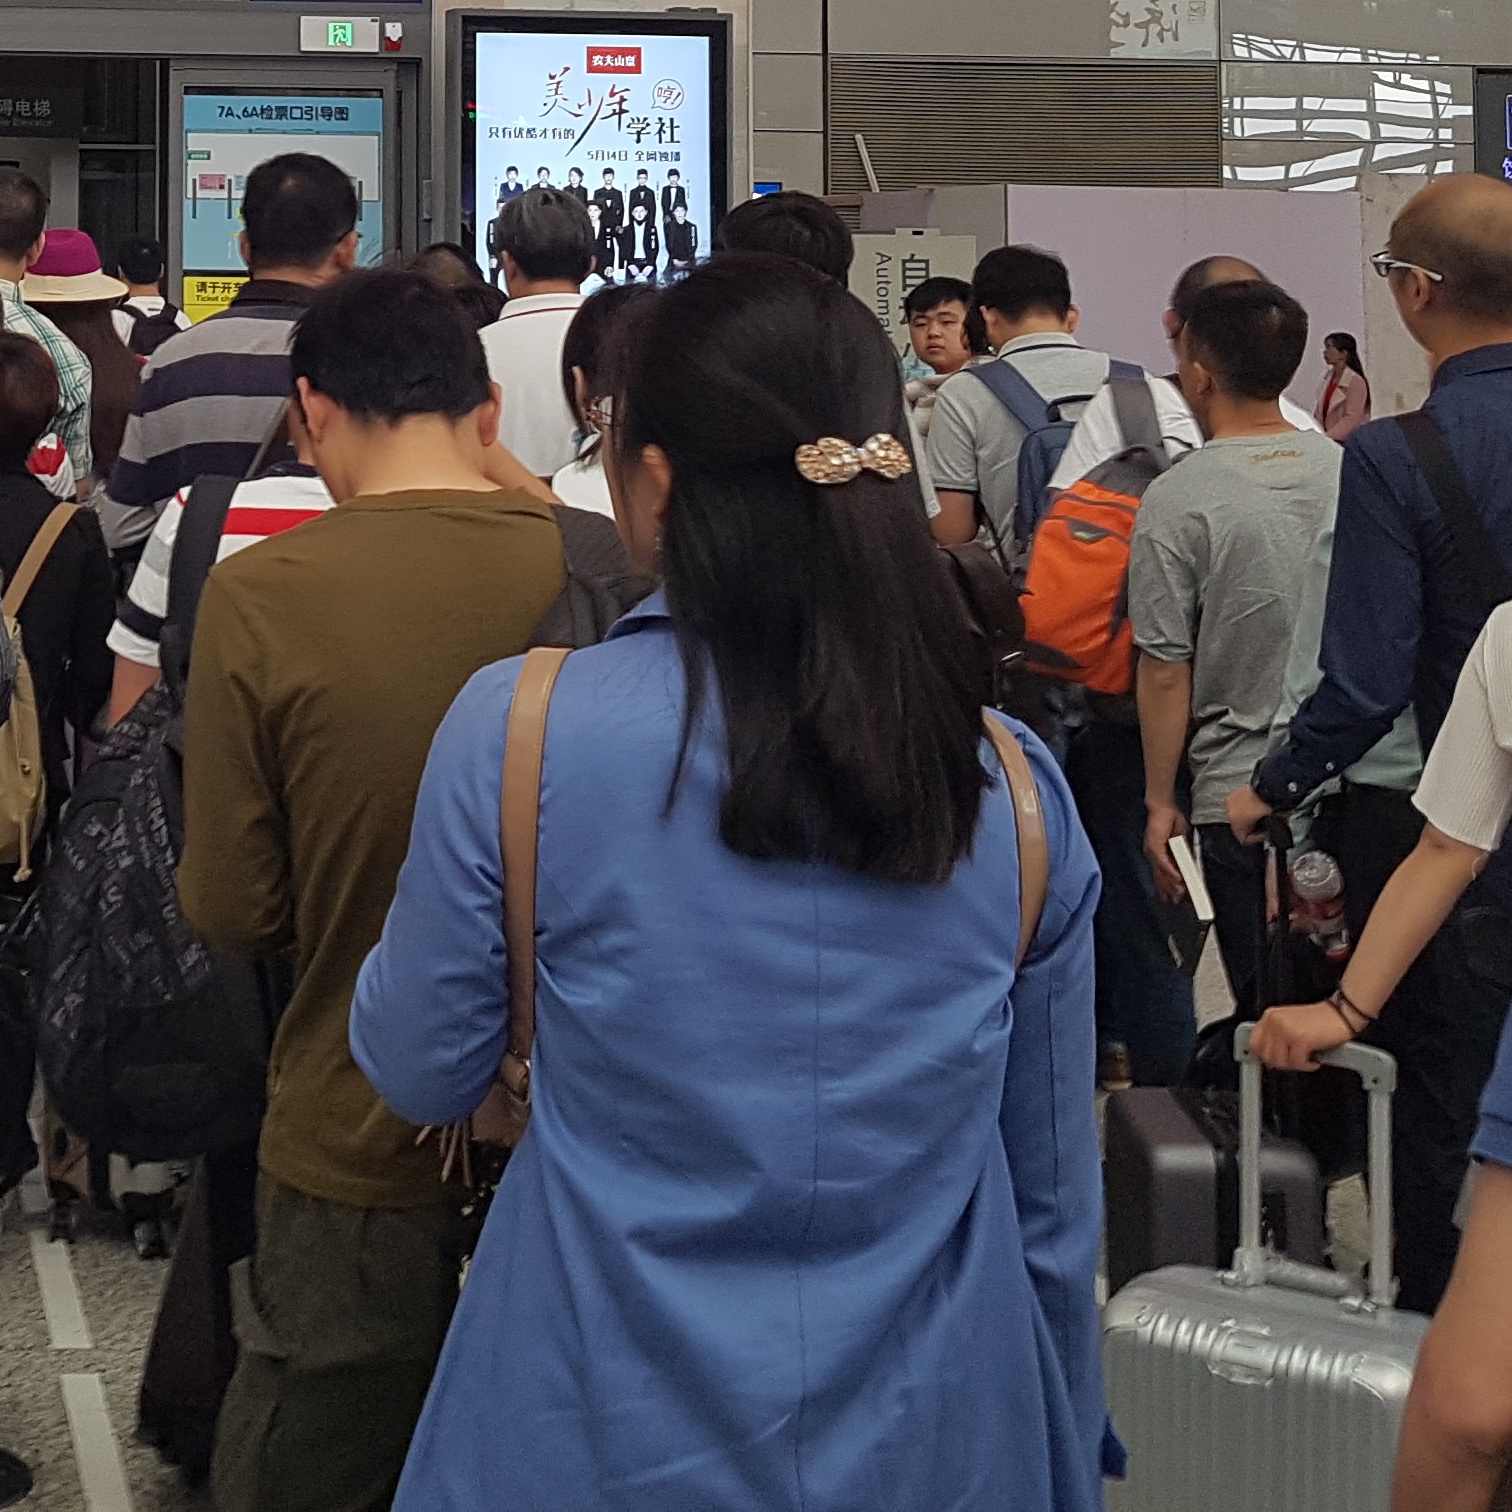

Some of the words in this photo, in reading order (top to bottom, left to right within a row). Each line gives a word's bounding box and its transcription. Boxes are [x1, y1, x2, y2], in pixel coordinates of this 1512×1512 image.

[592, 54, 637, 67] 农夫山泉
[218, 104, 349, 121] 7A、6A检票口引导图
[488, 126, 575, 139] 只有优酷才有的
[587, 150, 628, 161] 5月14日
[195, 294, 219, 302] Ticket
